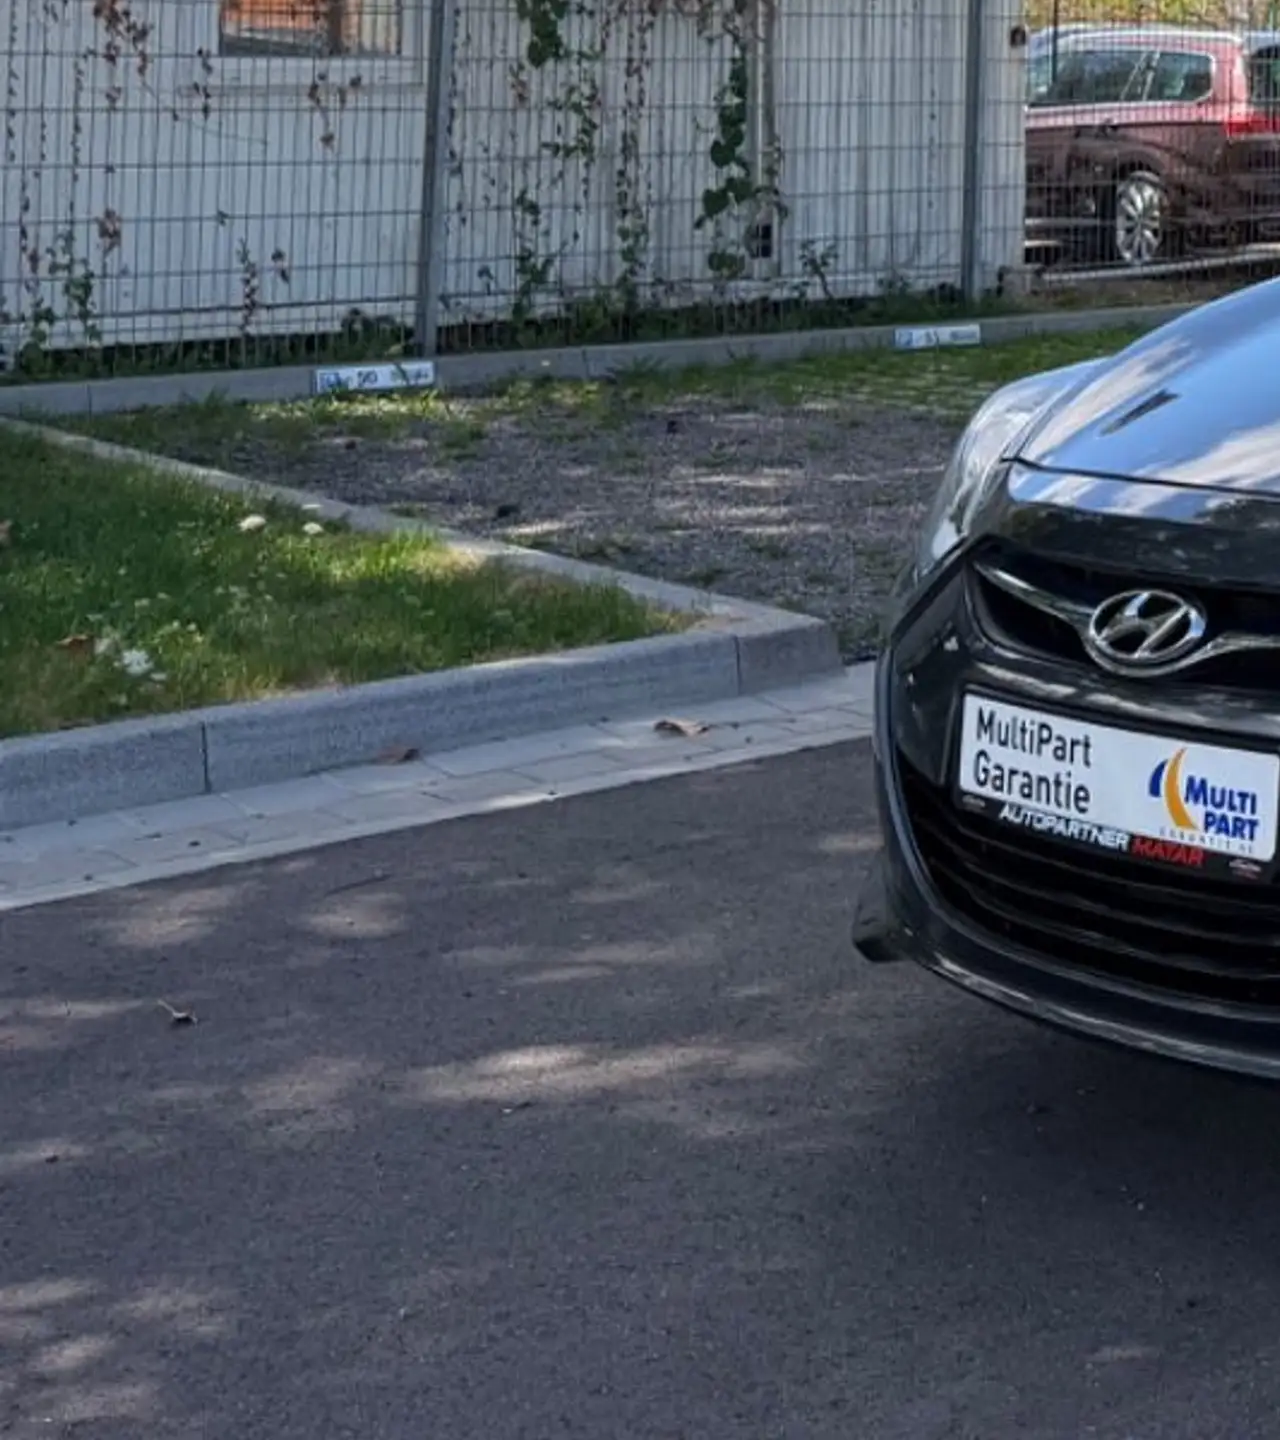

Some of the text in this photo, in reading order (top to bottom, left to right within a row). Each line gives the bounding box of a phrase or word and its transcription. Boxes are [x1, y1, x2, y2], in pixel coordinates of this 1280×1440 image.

[976, 706, 1092, 768] MultiPart
[973, 748, 1091, 814] Garantie
[999, 801, 1131, 852] AUTOPARTNER
[1203, 811, 1259, 842] PART
